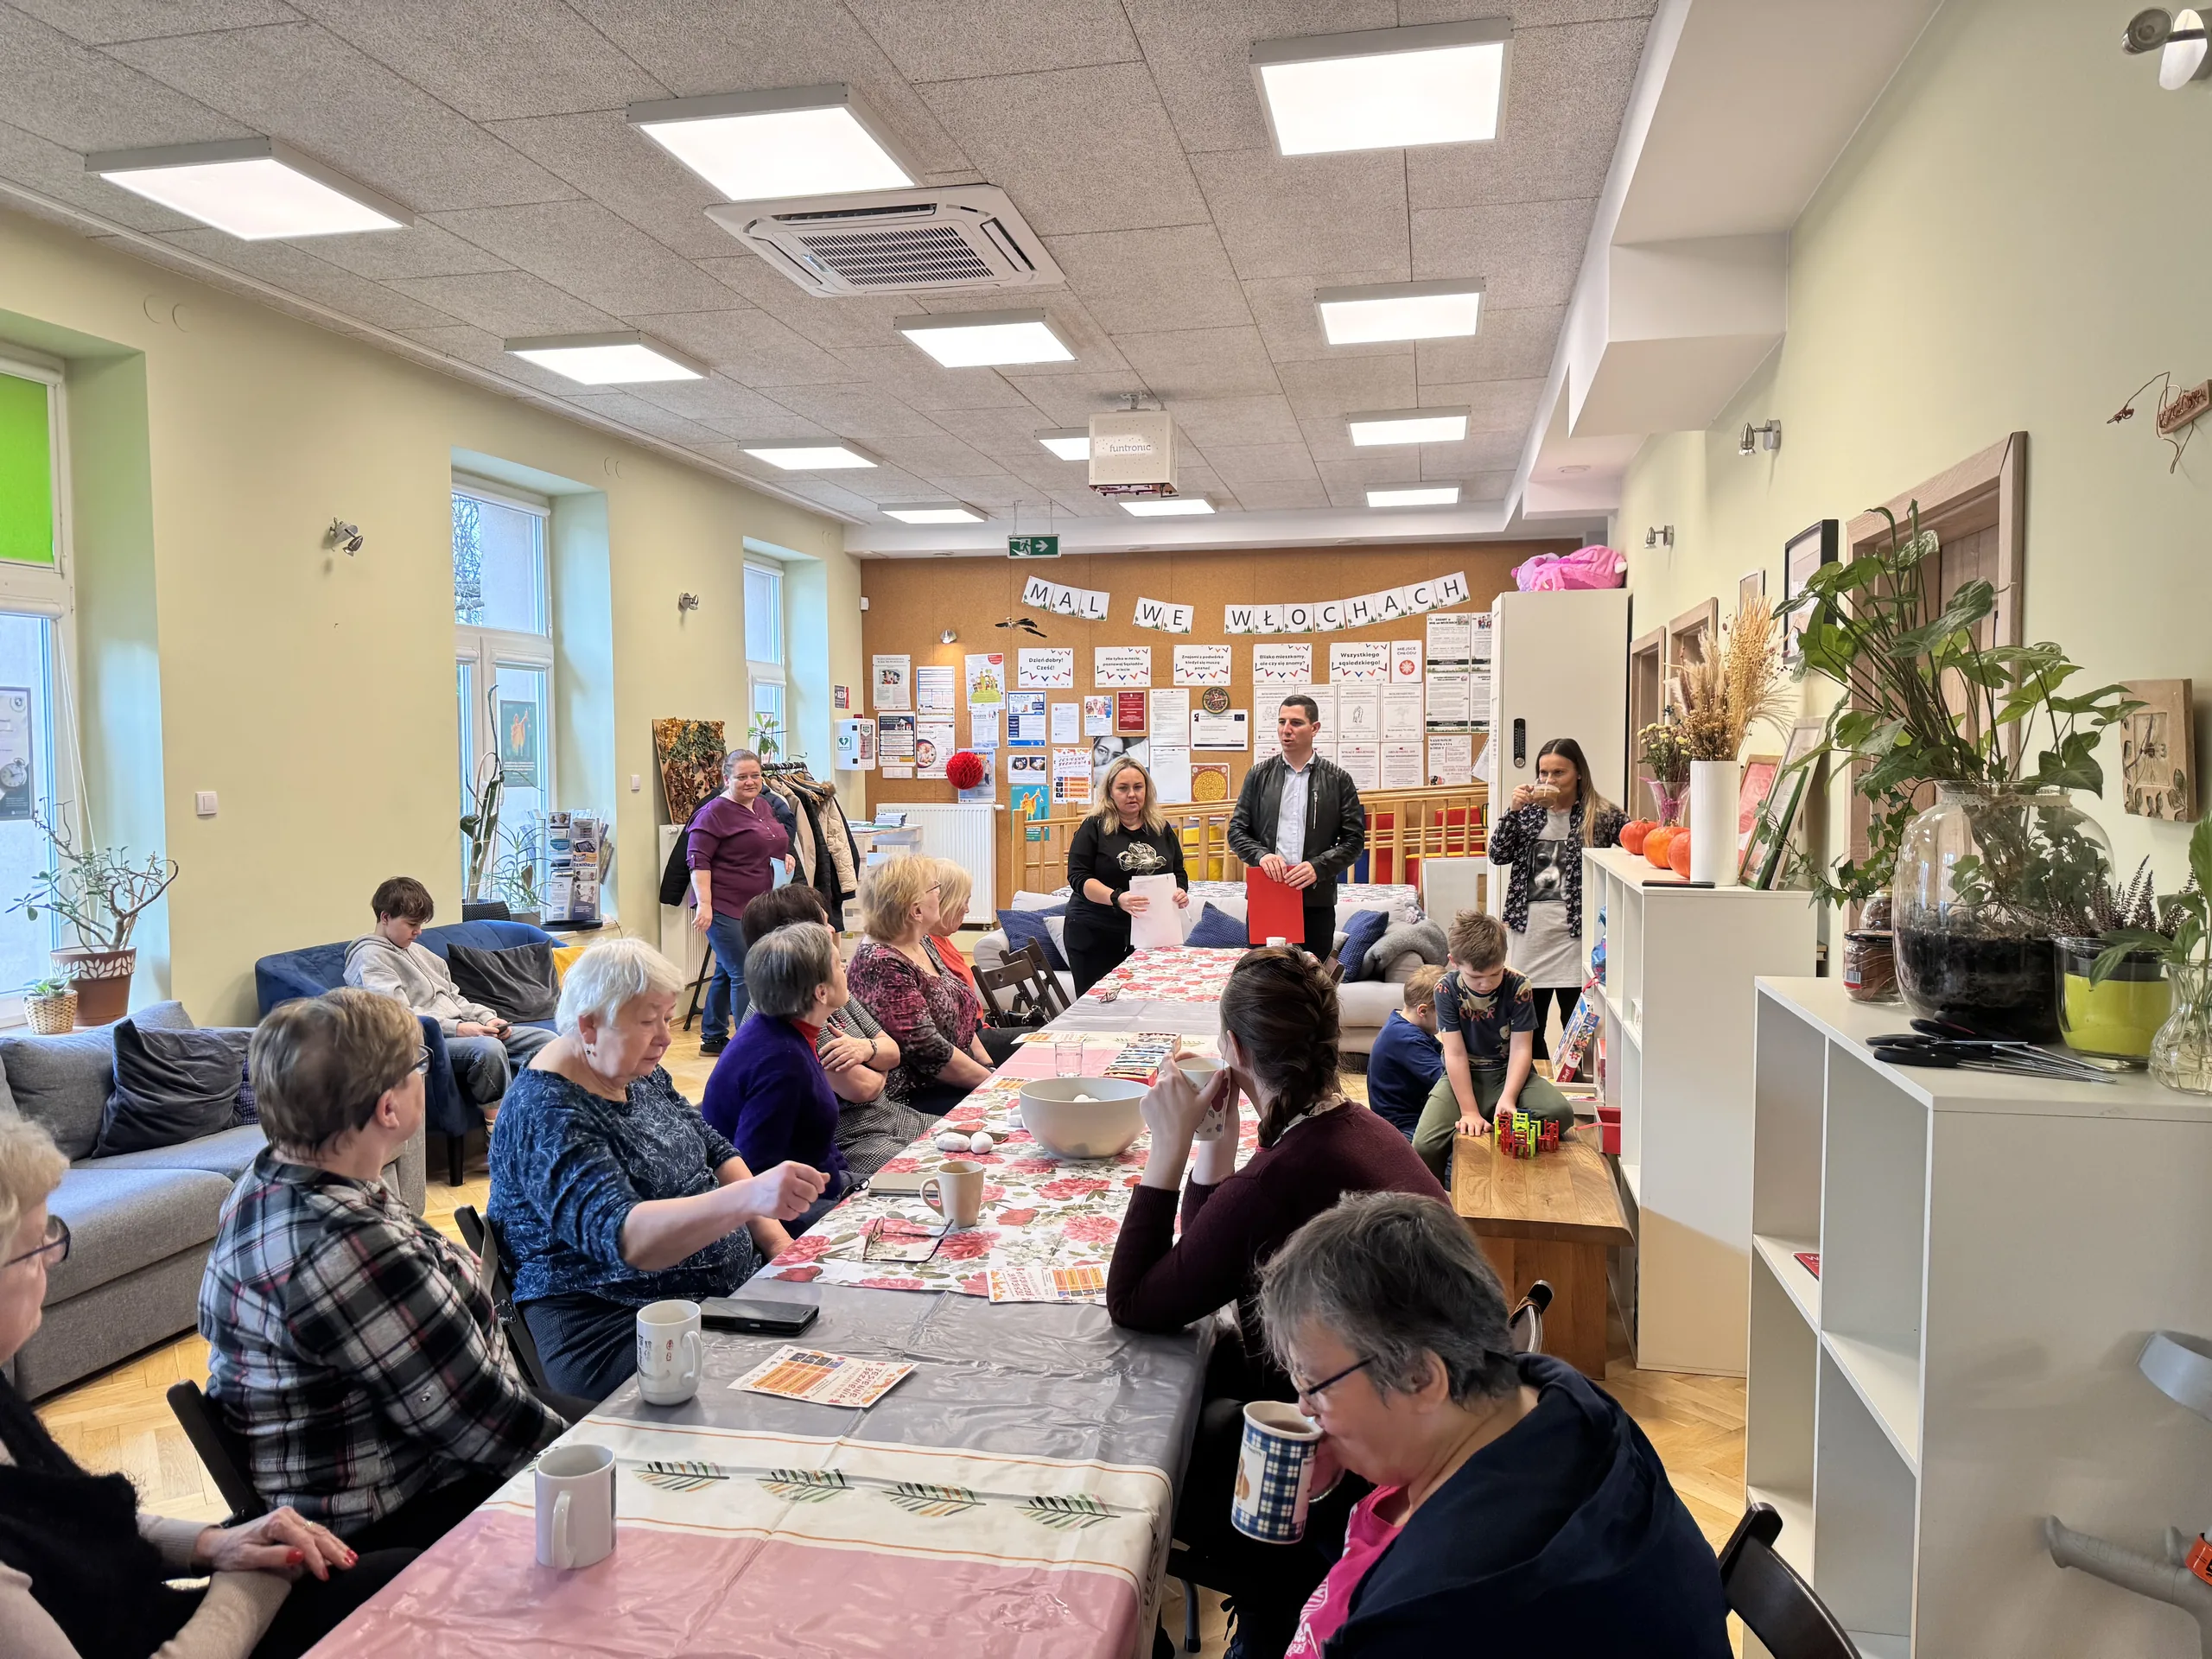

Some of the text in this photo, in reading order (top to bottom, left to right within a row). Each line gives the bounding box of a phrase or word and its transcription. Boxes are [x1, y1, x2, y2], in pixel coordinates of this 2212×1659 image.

[1030, 579, 1459, 626] MAL WE WŁOCHACH
